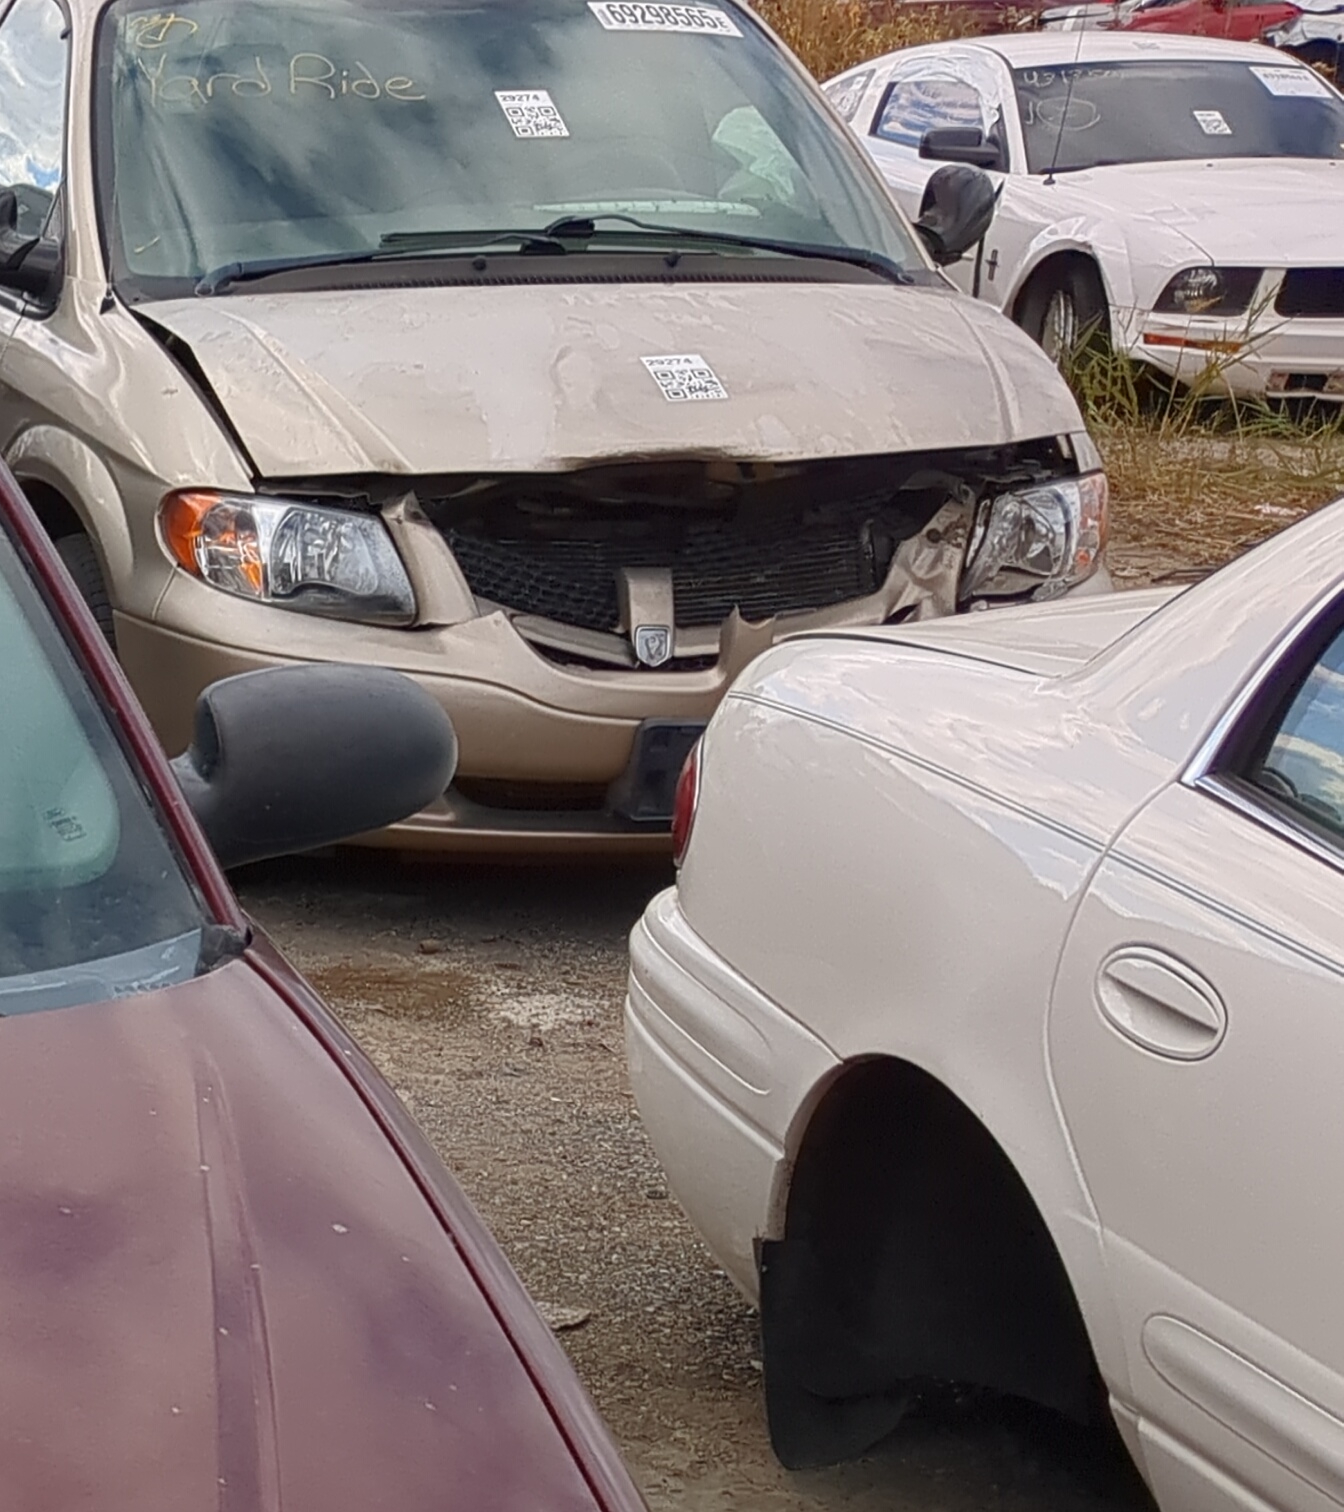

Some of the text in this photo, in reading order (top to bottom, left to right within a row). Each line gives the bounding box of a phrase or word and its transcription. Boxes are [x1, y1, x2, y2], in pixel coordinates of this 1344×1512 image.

[605, 3, 719, 29] 69298565
[137, 53, 426, 107] Yard Ride
